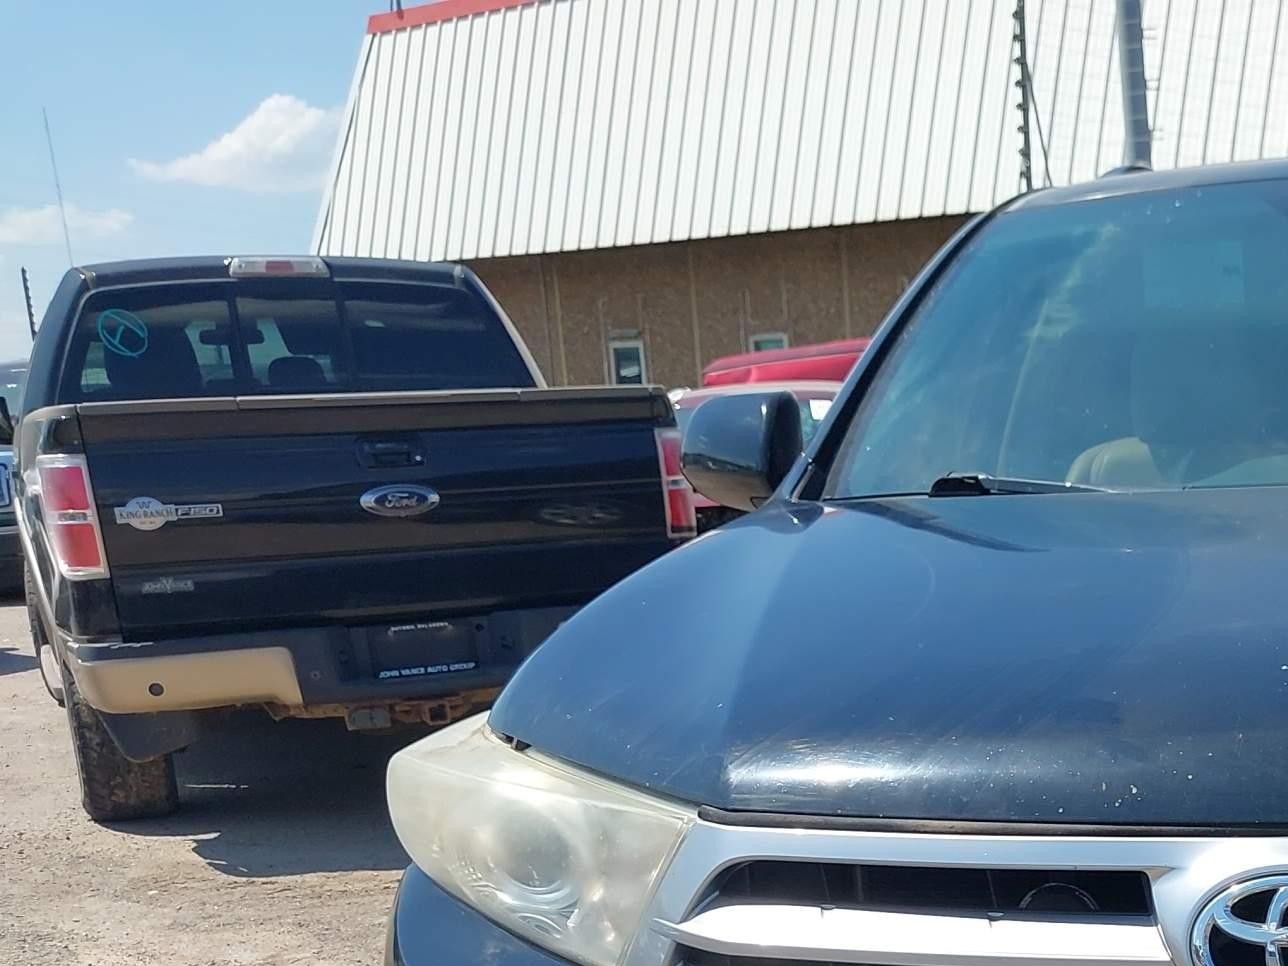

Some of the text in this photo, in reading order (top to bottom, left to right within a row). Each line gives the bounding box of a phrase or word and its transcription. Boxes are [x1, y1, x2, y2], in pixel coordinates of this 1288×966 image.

[384, 493, 418, 508] Ford
[119, 508, 175, 519] KING RANCH
[379, 662, 476, 678] JOHN VANCE AUTO GROUP
